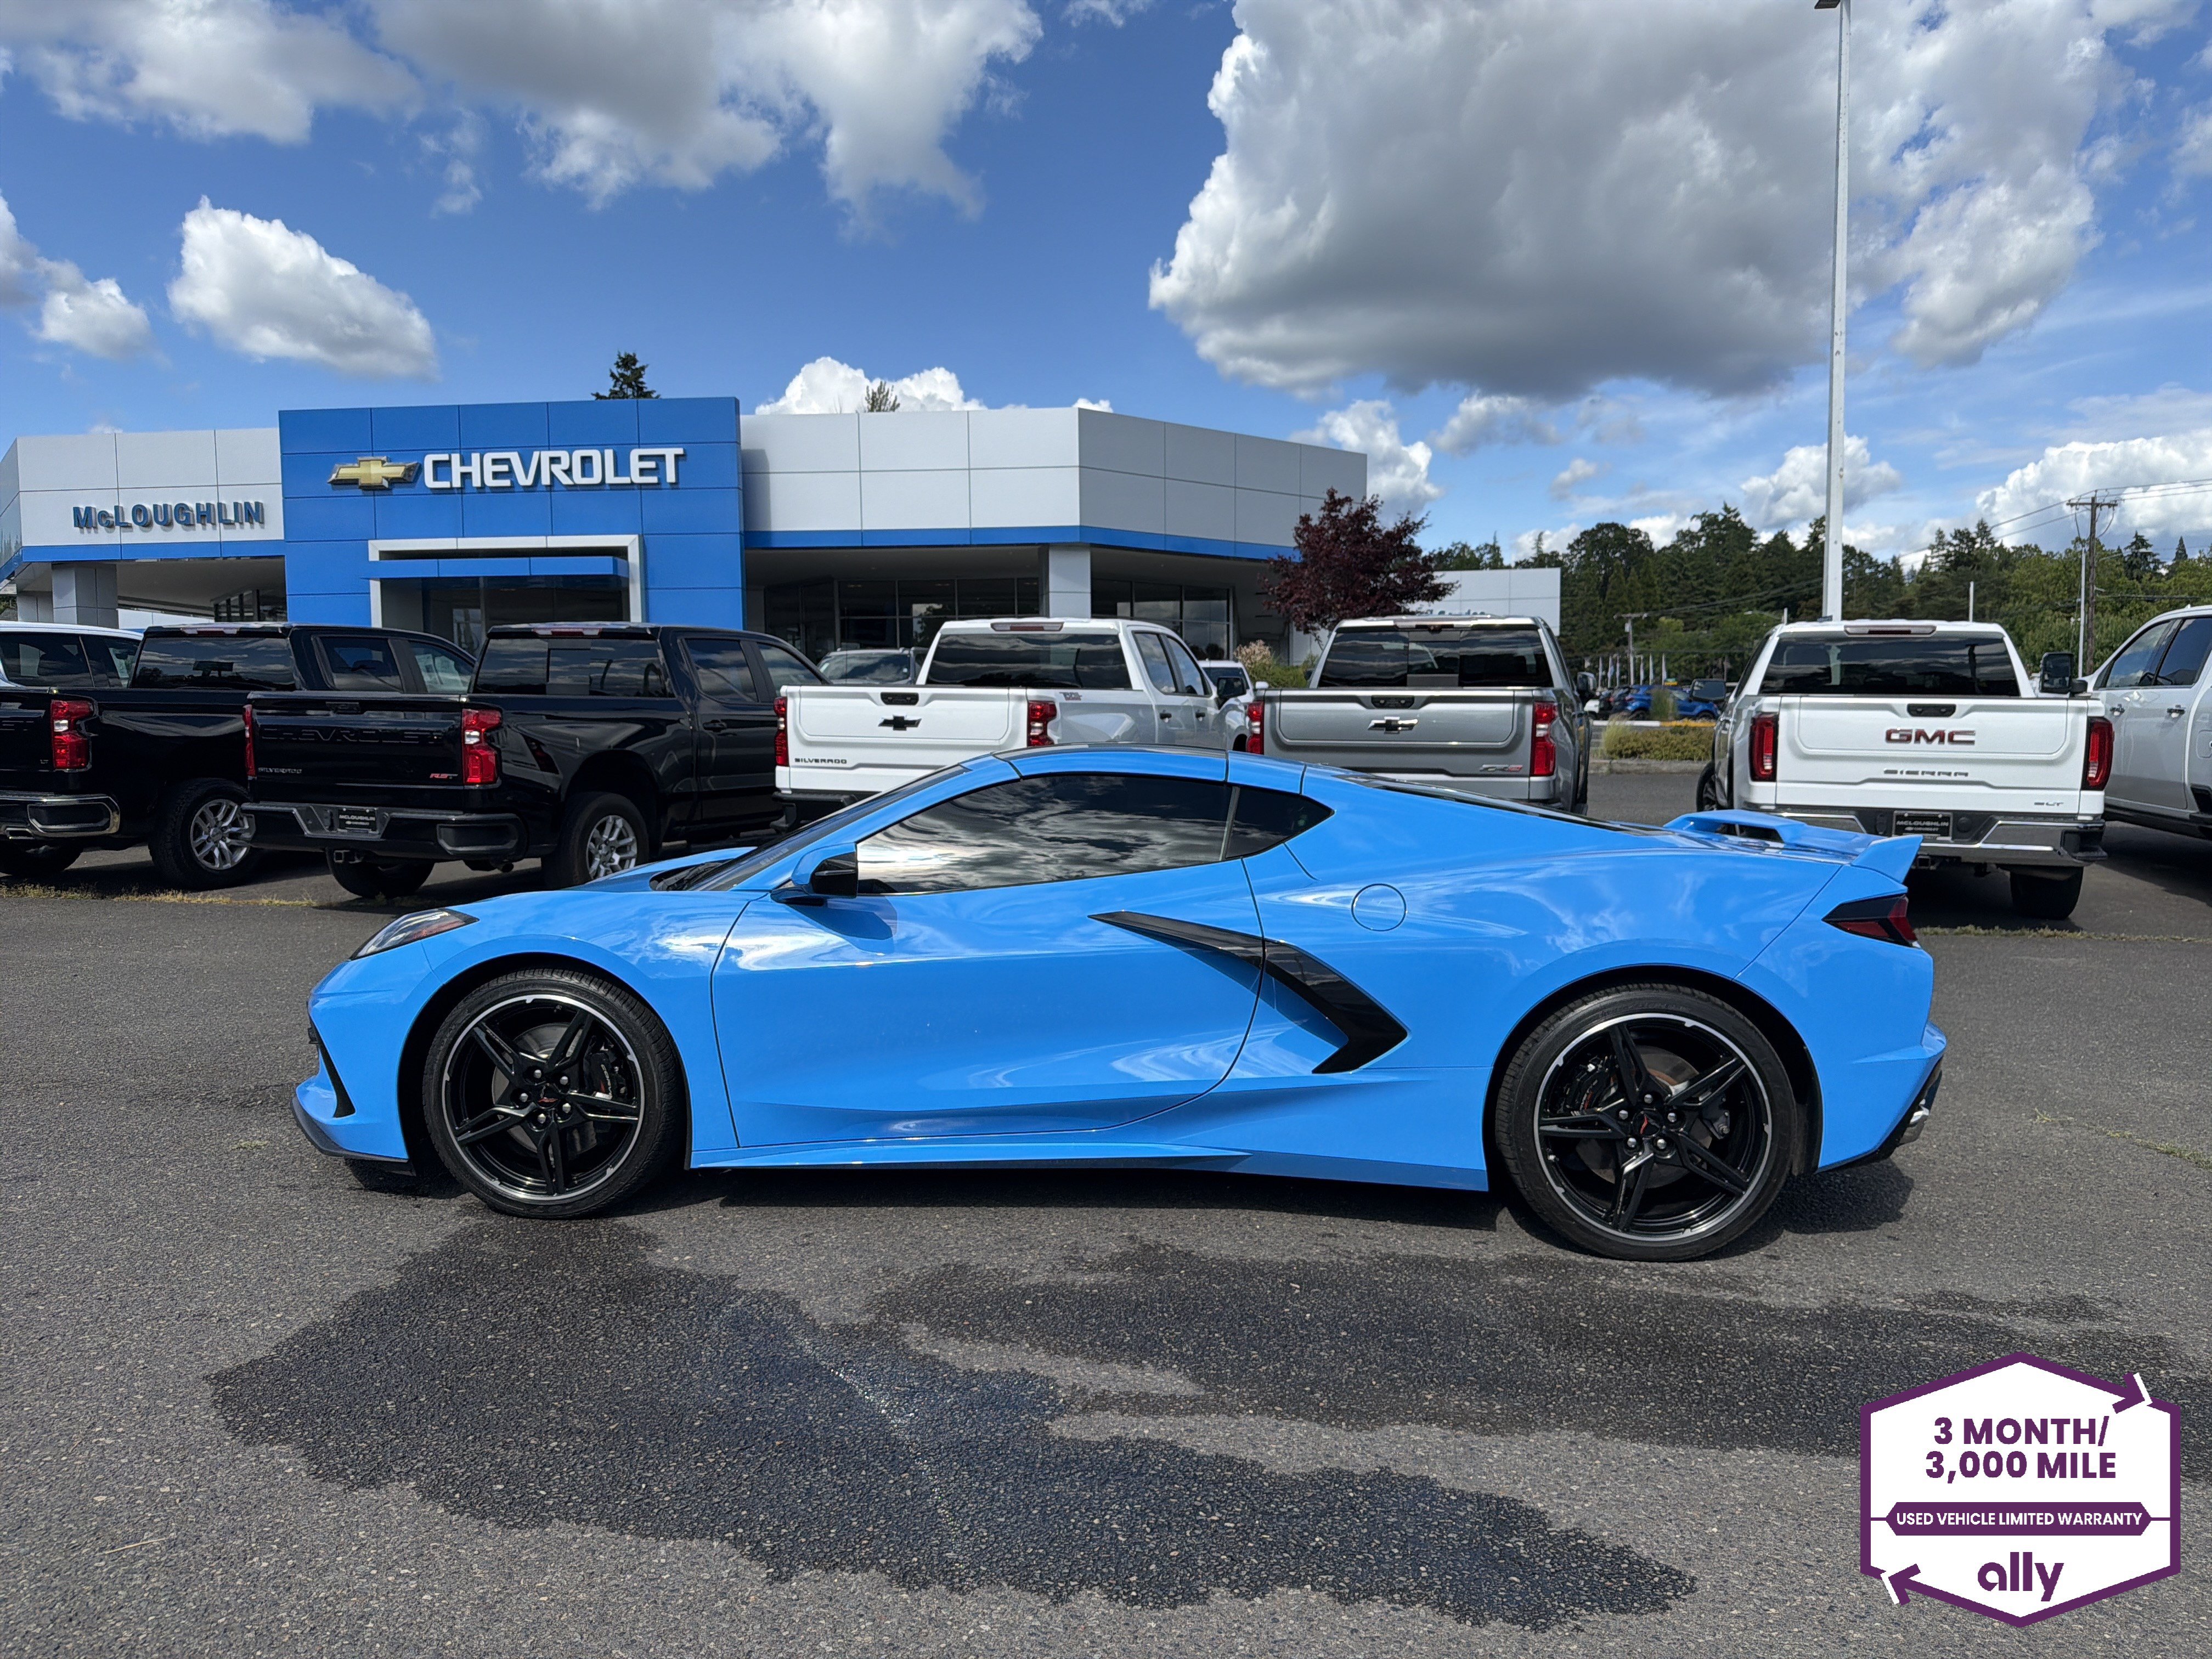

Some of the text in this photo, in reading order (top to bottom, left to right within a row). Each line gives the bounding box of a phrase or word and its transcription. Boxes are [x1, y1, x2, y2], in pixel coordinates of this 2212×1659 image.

[424, 448, 684, 488] CHEVROLET
[72, 501, 263, 528] McLOUGHLIN
[1885, 729, 1975, 744] GMC
